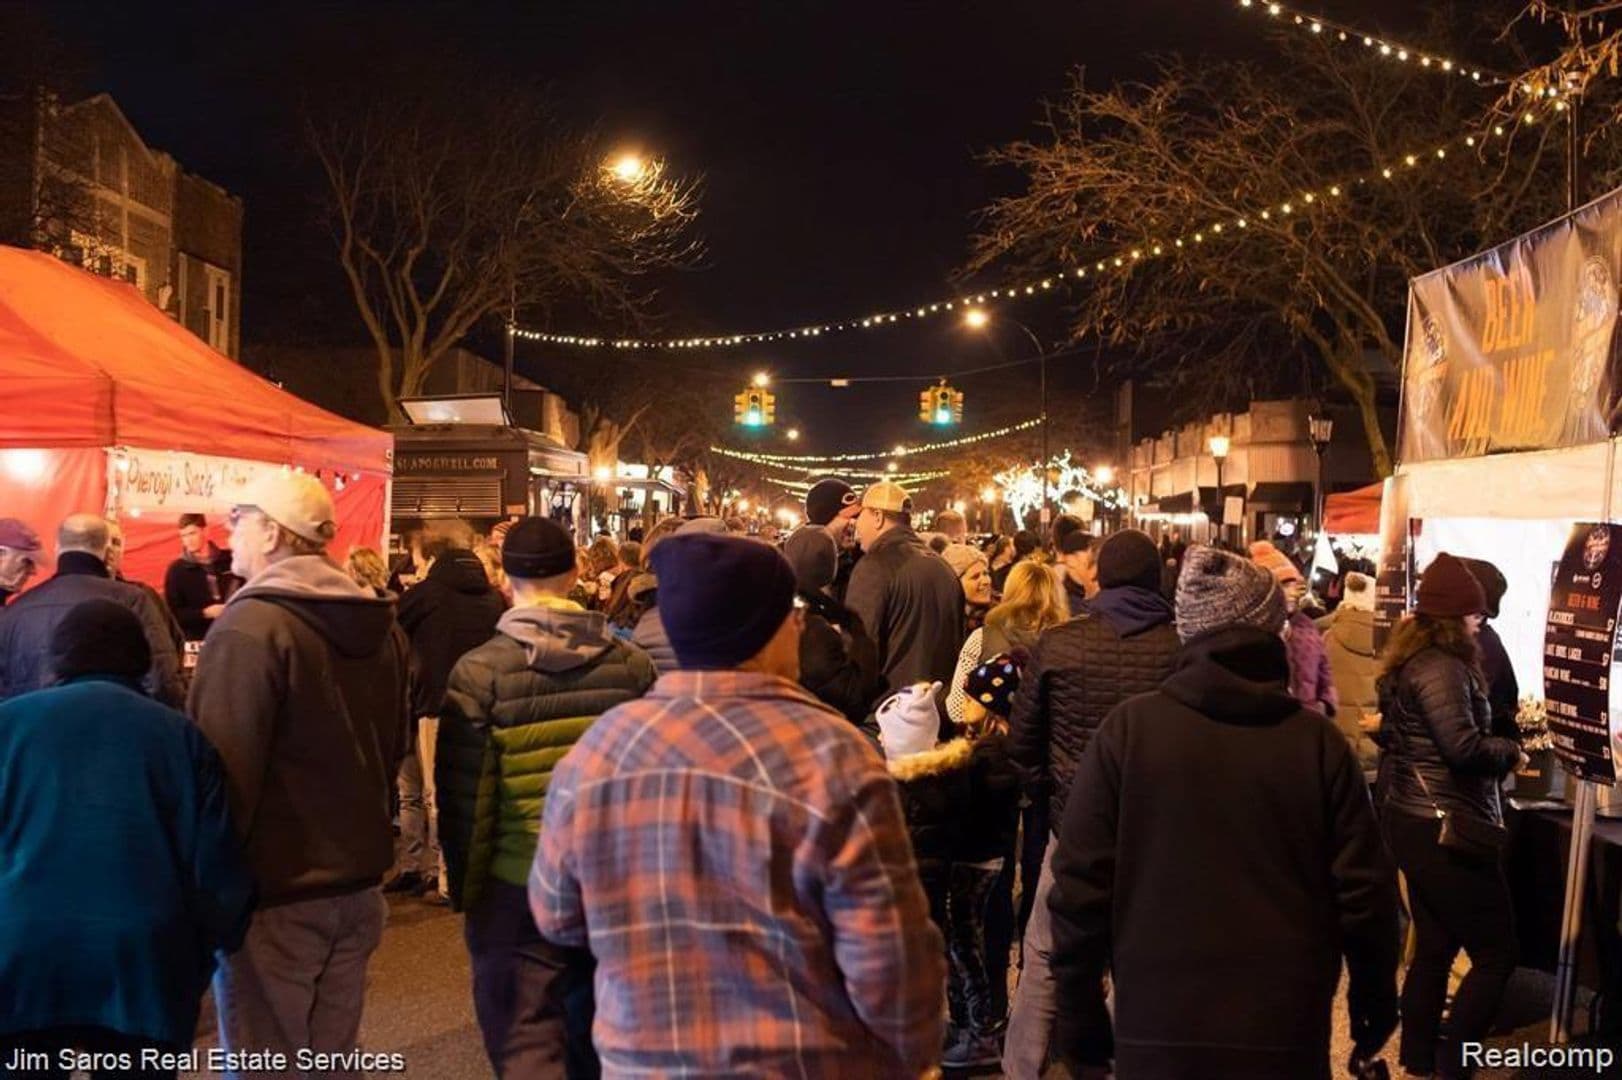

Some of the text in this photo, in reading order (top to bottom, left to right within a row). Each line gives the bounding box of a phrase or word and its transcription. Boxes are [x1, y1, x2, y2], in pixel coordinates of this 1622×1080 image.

[1482, 278, 1536, 353] BEER
[1448, 366, 1496, 439] AND
[127, 457, 173, 504] Pierogi
